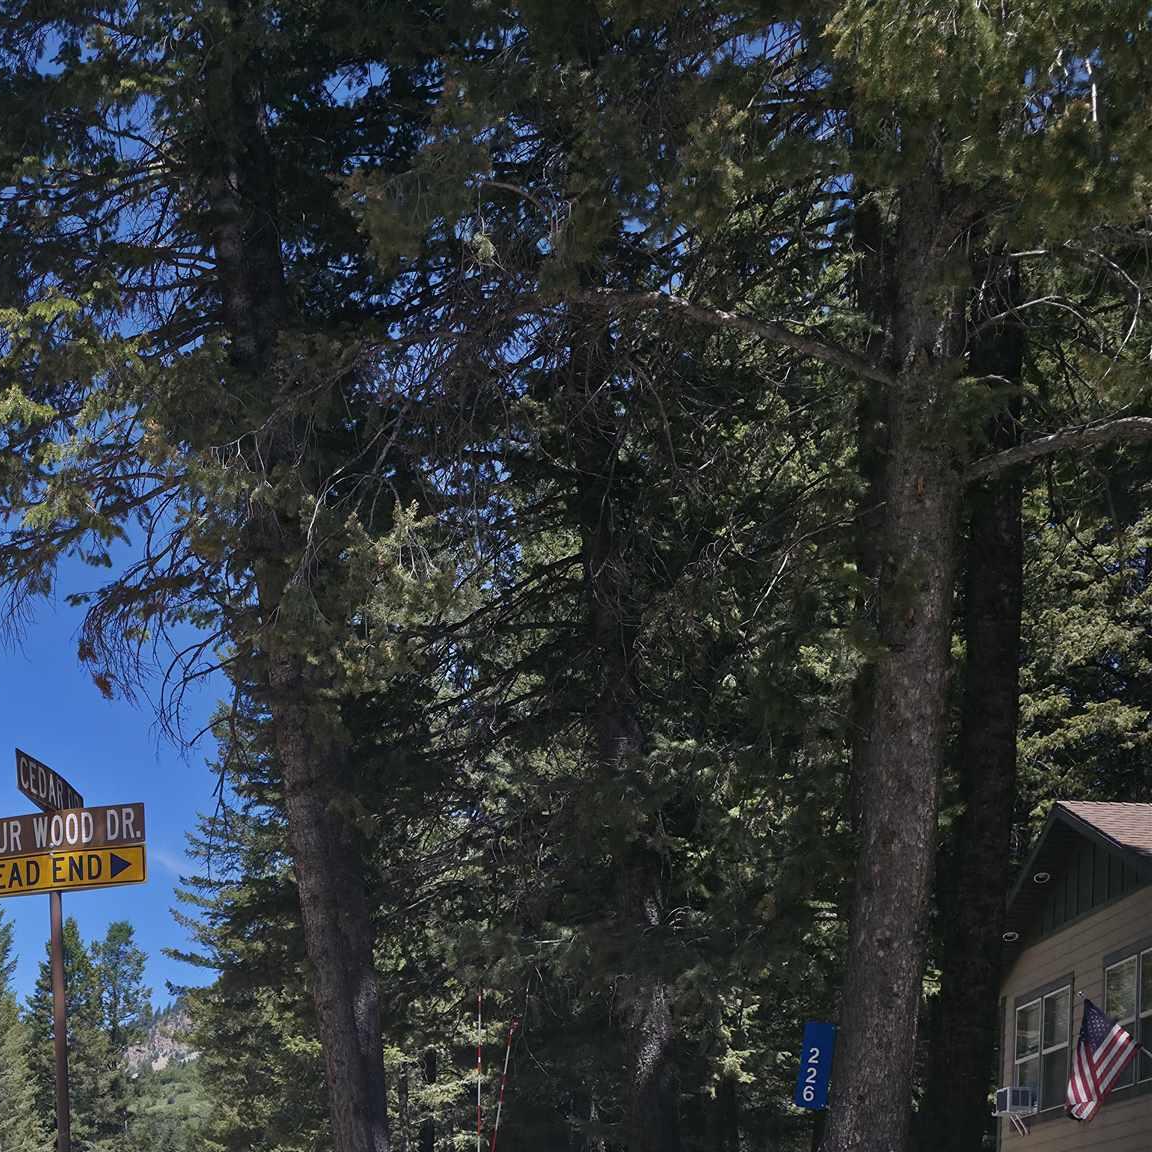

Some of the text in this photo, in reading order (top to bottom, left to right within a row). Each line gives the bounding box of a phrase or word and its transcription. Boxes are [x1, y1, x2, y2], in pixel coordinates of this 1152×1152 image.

[19, 756, 64, 812] CEDAR
[33, 811, 94, 849] WOOD
[106, 807, 142, 841] DR.
[52, 853, 103, 884] END
[802, 1047, 820, 1102] 226
